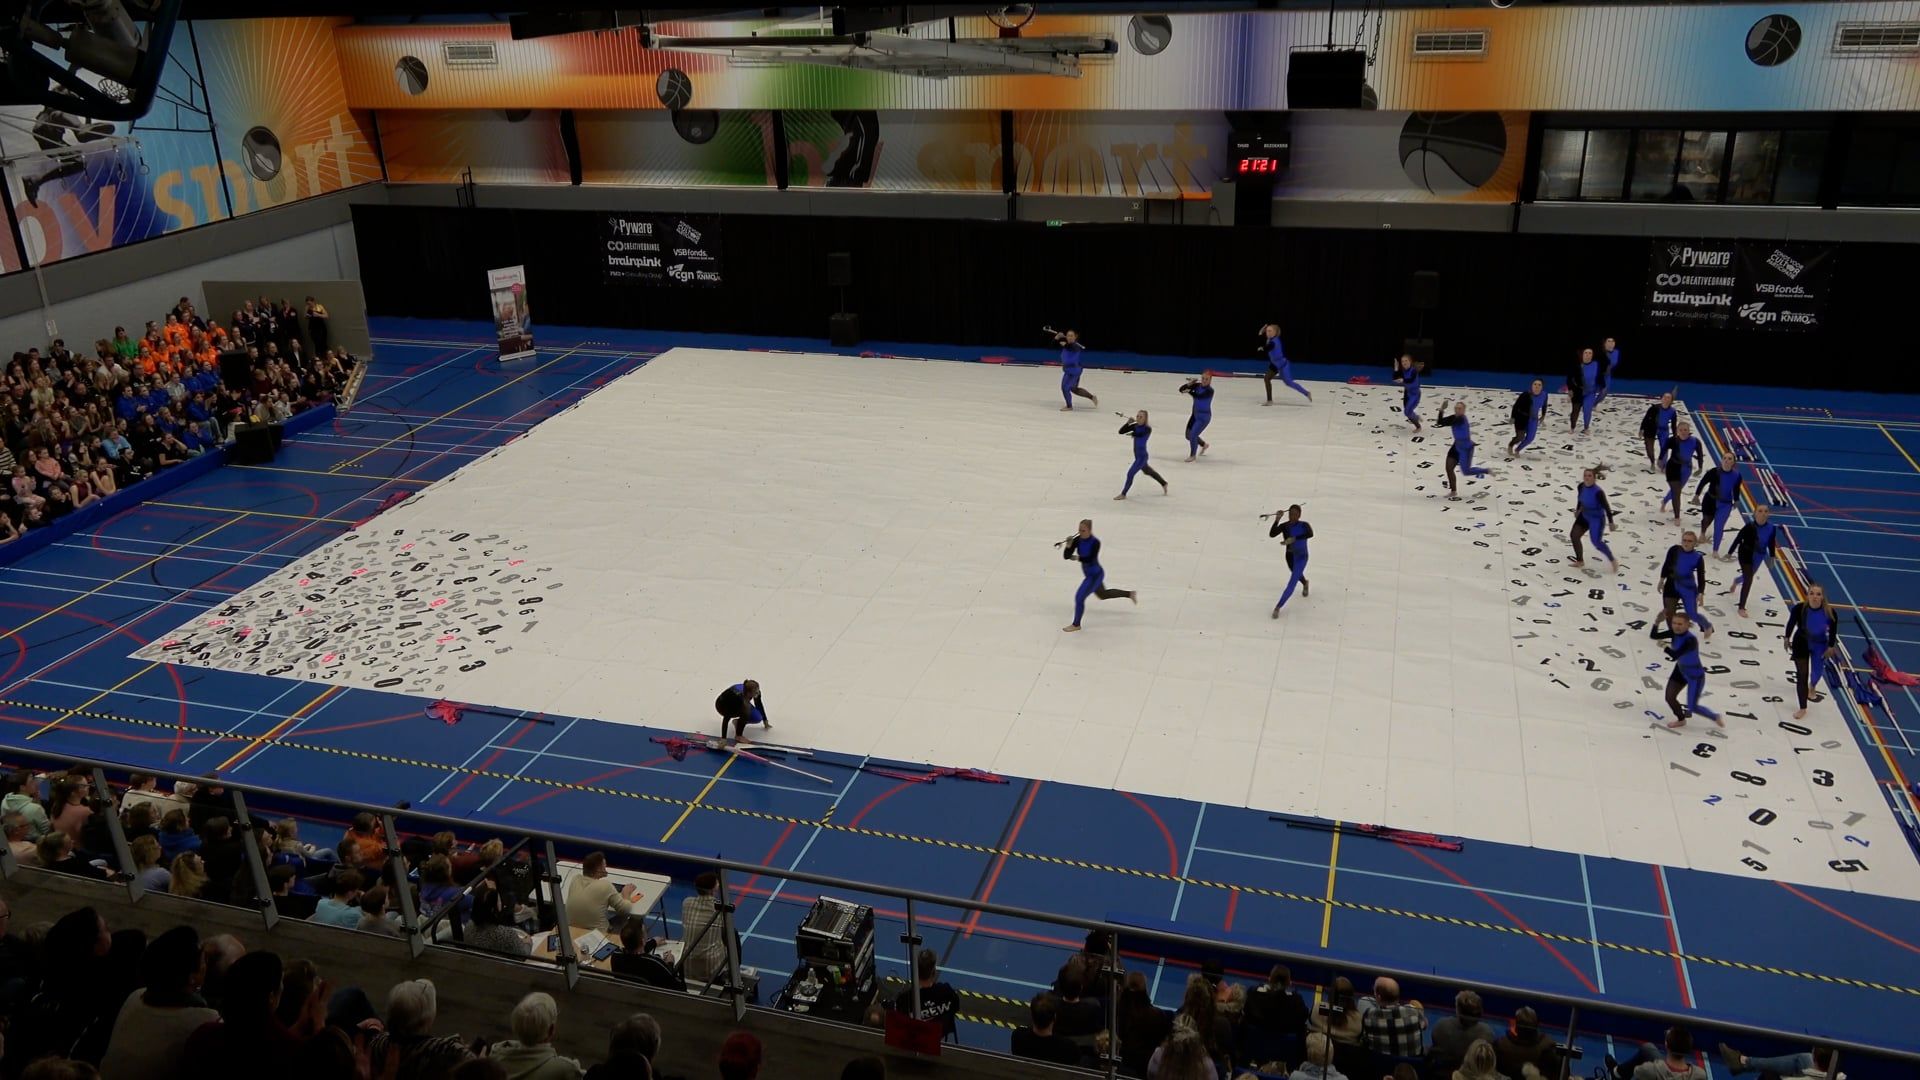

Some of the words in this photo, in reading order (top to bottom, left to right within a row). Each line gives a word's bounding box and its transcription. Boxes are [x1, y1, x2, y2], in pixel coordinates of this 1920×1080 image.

[1240, 159, 1277, 172] 21:21
[620, 219, 652, 236] Pyware
[608, 256, 662, 268] brainpink
[1682, 247, 1730, 266] Pyware
[675, 271, 694, 282] cgn
[1656, 273, 1681, 286] CO
[1682, 276, 1736, 286] CREATIVEORANGE
[1653, 291, 1732, 306] brainpink
[1749, 310, 1776, 324] cgn
[1780, 314, 1810, 324] KNMO
[448, 533, 470, 542] 0
[453, 577, 478, 585] 3
[1588, 589, 1605, 600] 8
[1511, 596, 1532, 606] 4
[218, 605, 243, 616] 5
[1602, 607, 1614, 615] 5
[395, 622, 422, 630] 4
[478, 624, 503, 636] 4
[1728, 631, 1758, 640] 8
[246, 640, 270, 654] 2
[1599, 646, 1626, 658] 5
[362, 657, 378, 665] 3
[459, 660, 486, 672] 3
[1578, 658, 1602, 672] 2
[1646, 663, 1661, 671] 2
[266, 665, 294, 676] 3
[322, 670, 338, 679] 3
[374, 678, 404, 688] 0
[1778, 721, 1812, 736] 0
[1692, 743, 1716, 758] 3
[1730, 771, 1767, 786] 8
[1812, 769, 1834, 787] 3
[1703, 795, 1722, 806] 2
[1748, 808, 1777, 826] 0
[1742, 840, 1770, 855] 1
[1844, 836, 1870, 847] 2
[1740, 857, 1768, 872] 5
[1828, 859, 1870, 872] 5
[910, 1001, 952, 1019] REW
